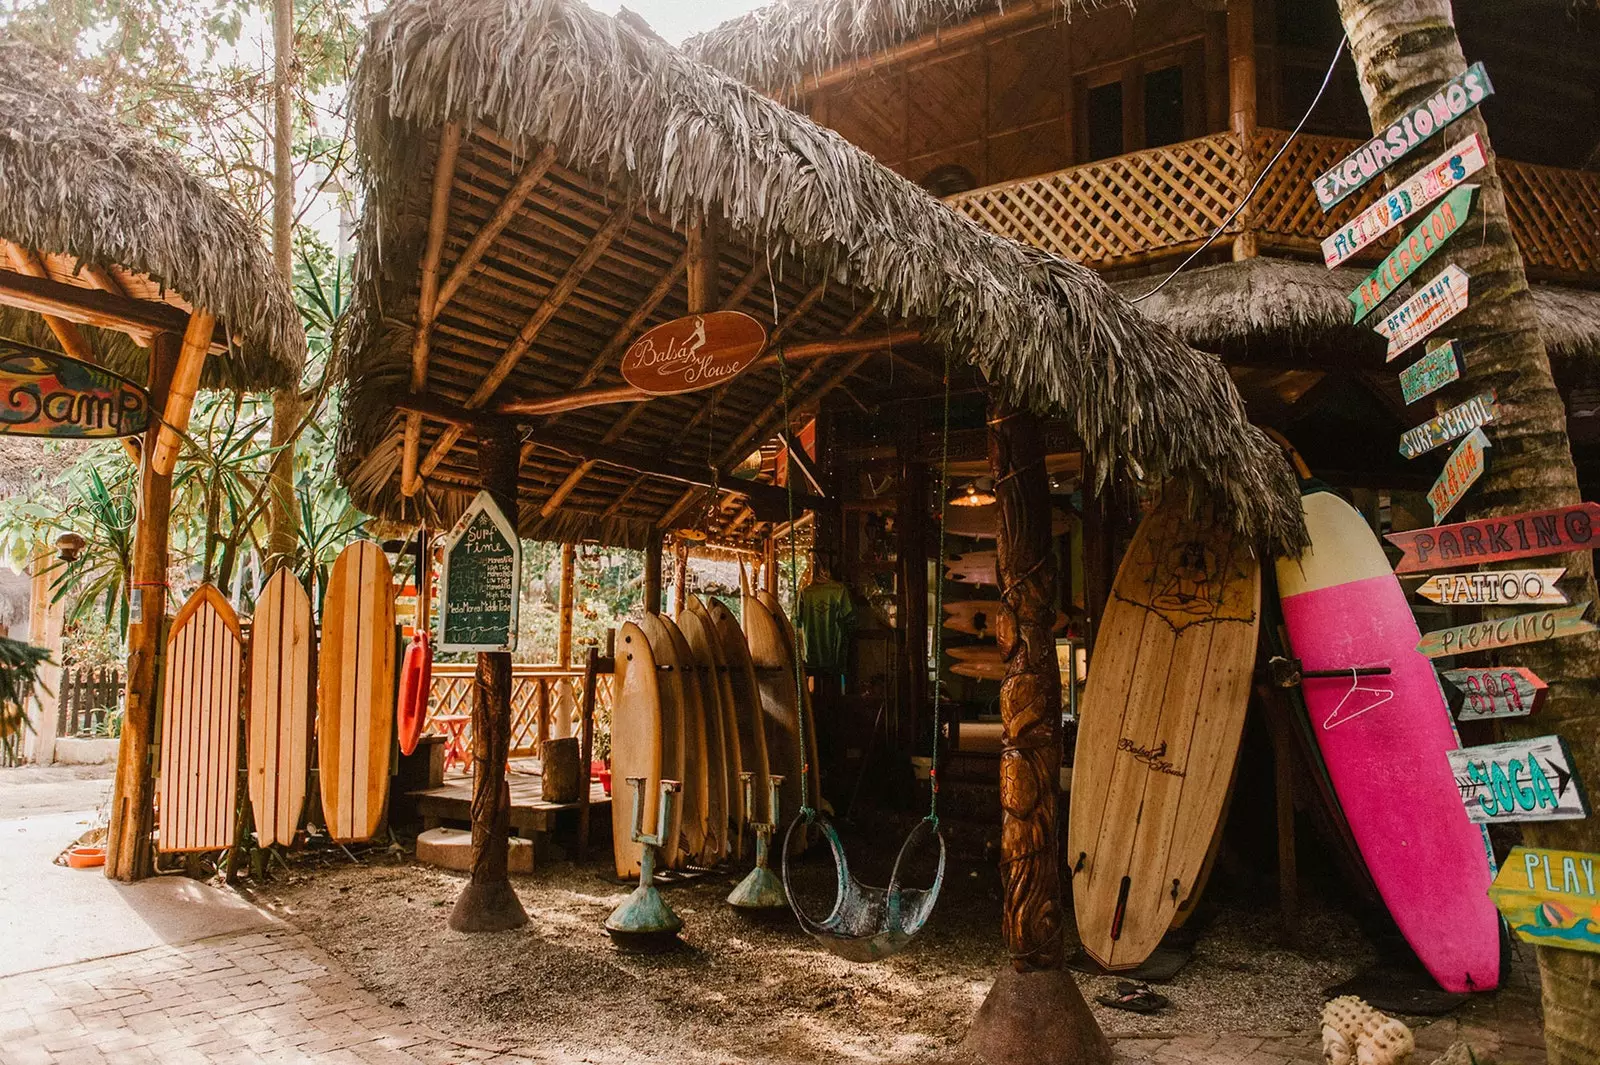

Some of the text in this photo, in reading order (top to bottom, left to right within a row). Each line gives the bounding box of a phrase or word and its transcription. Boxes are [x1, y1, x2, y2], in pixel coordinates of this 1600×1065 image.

[1317, 74, 1483, 204] EXCURSIONES
[684, 353, 740, 384] House
[1403, 397, 1493, 457] SURF SCHOOL
[467, 525, 498, 542] Surf
[1413, 510, 1593, 563] PARKING
[1436, 572, 1544, 603] TATTOO
[1466, 672, 1524, 714] SPA
[1523, 852, 1596, 896] PLAY
